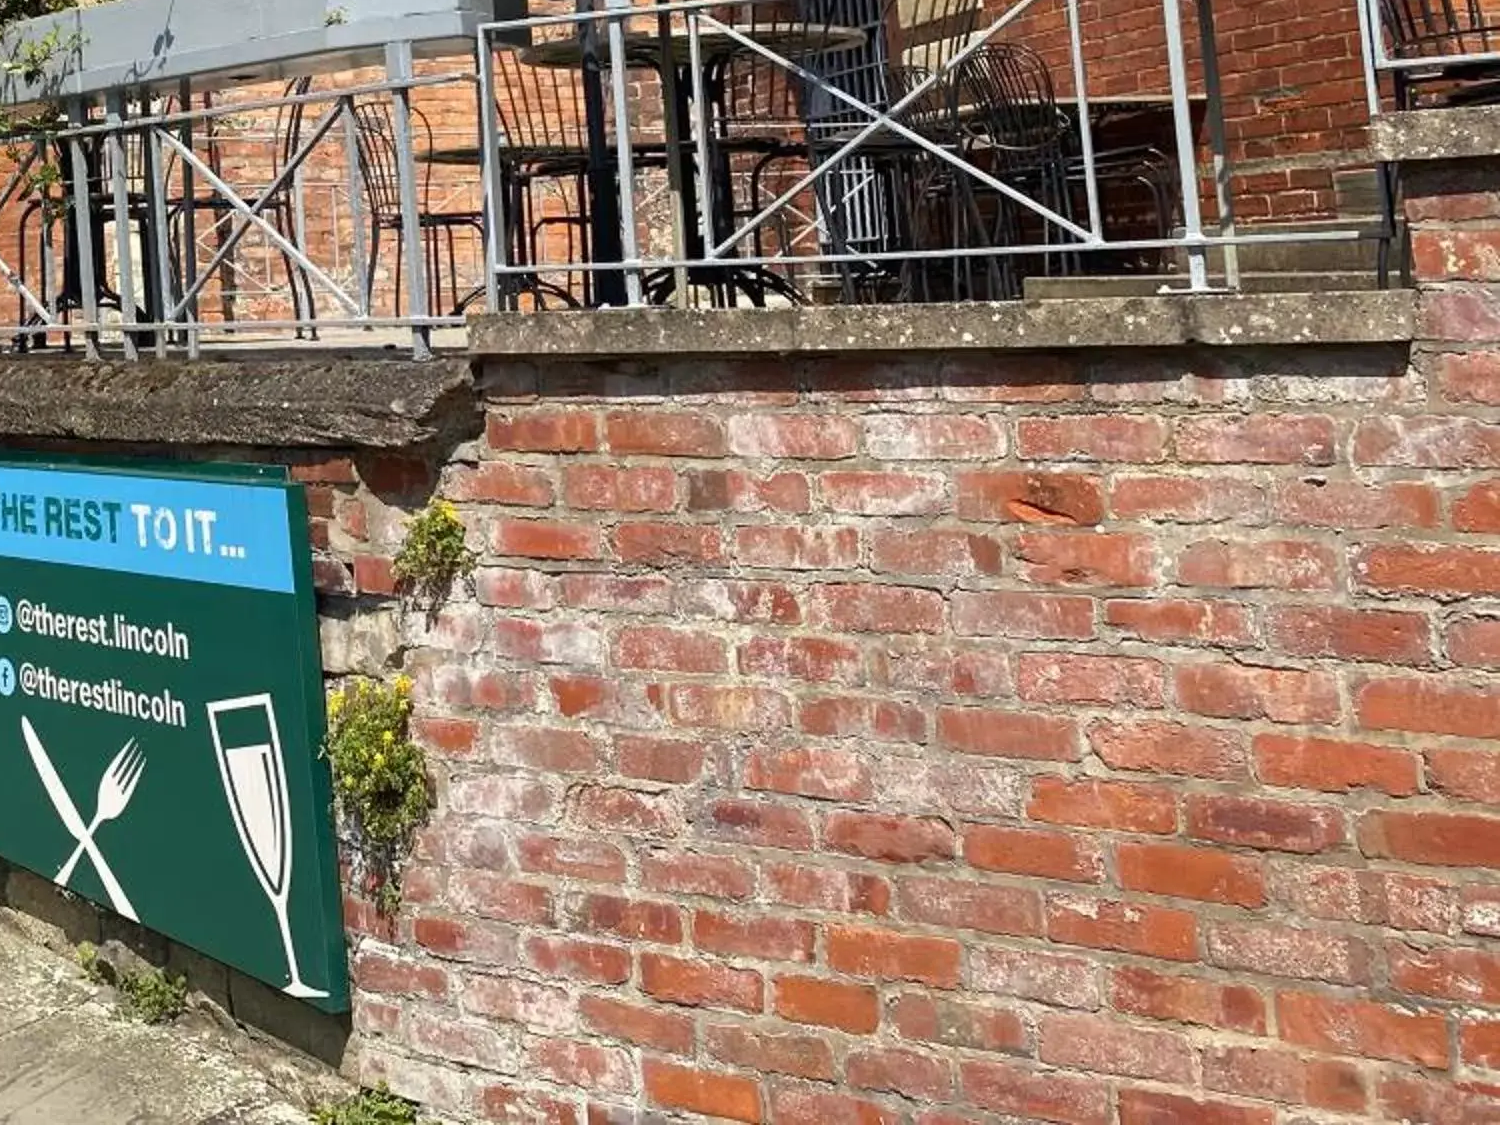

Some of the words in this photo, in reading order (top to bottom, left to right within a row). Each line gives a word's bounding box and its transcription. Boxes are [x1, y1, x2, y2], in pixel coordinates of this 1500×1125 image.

[43, 496, 122, 544] REST
[131, 503, 178, 552] TO
[15, 598, 190, 661] @therest.lincoln
[19, 661, 187, 728] @therestlincoln
